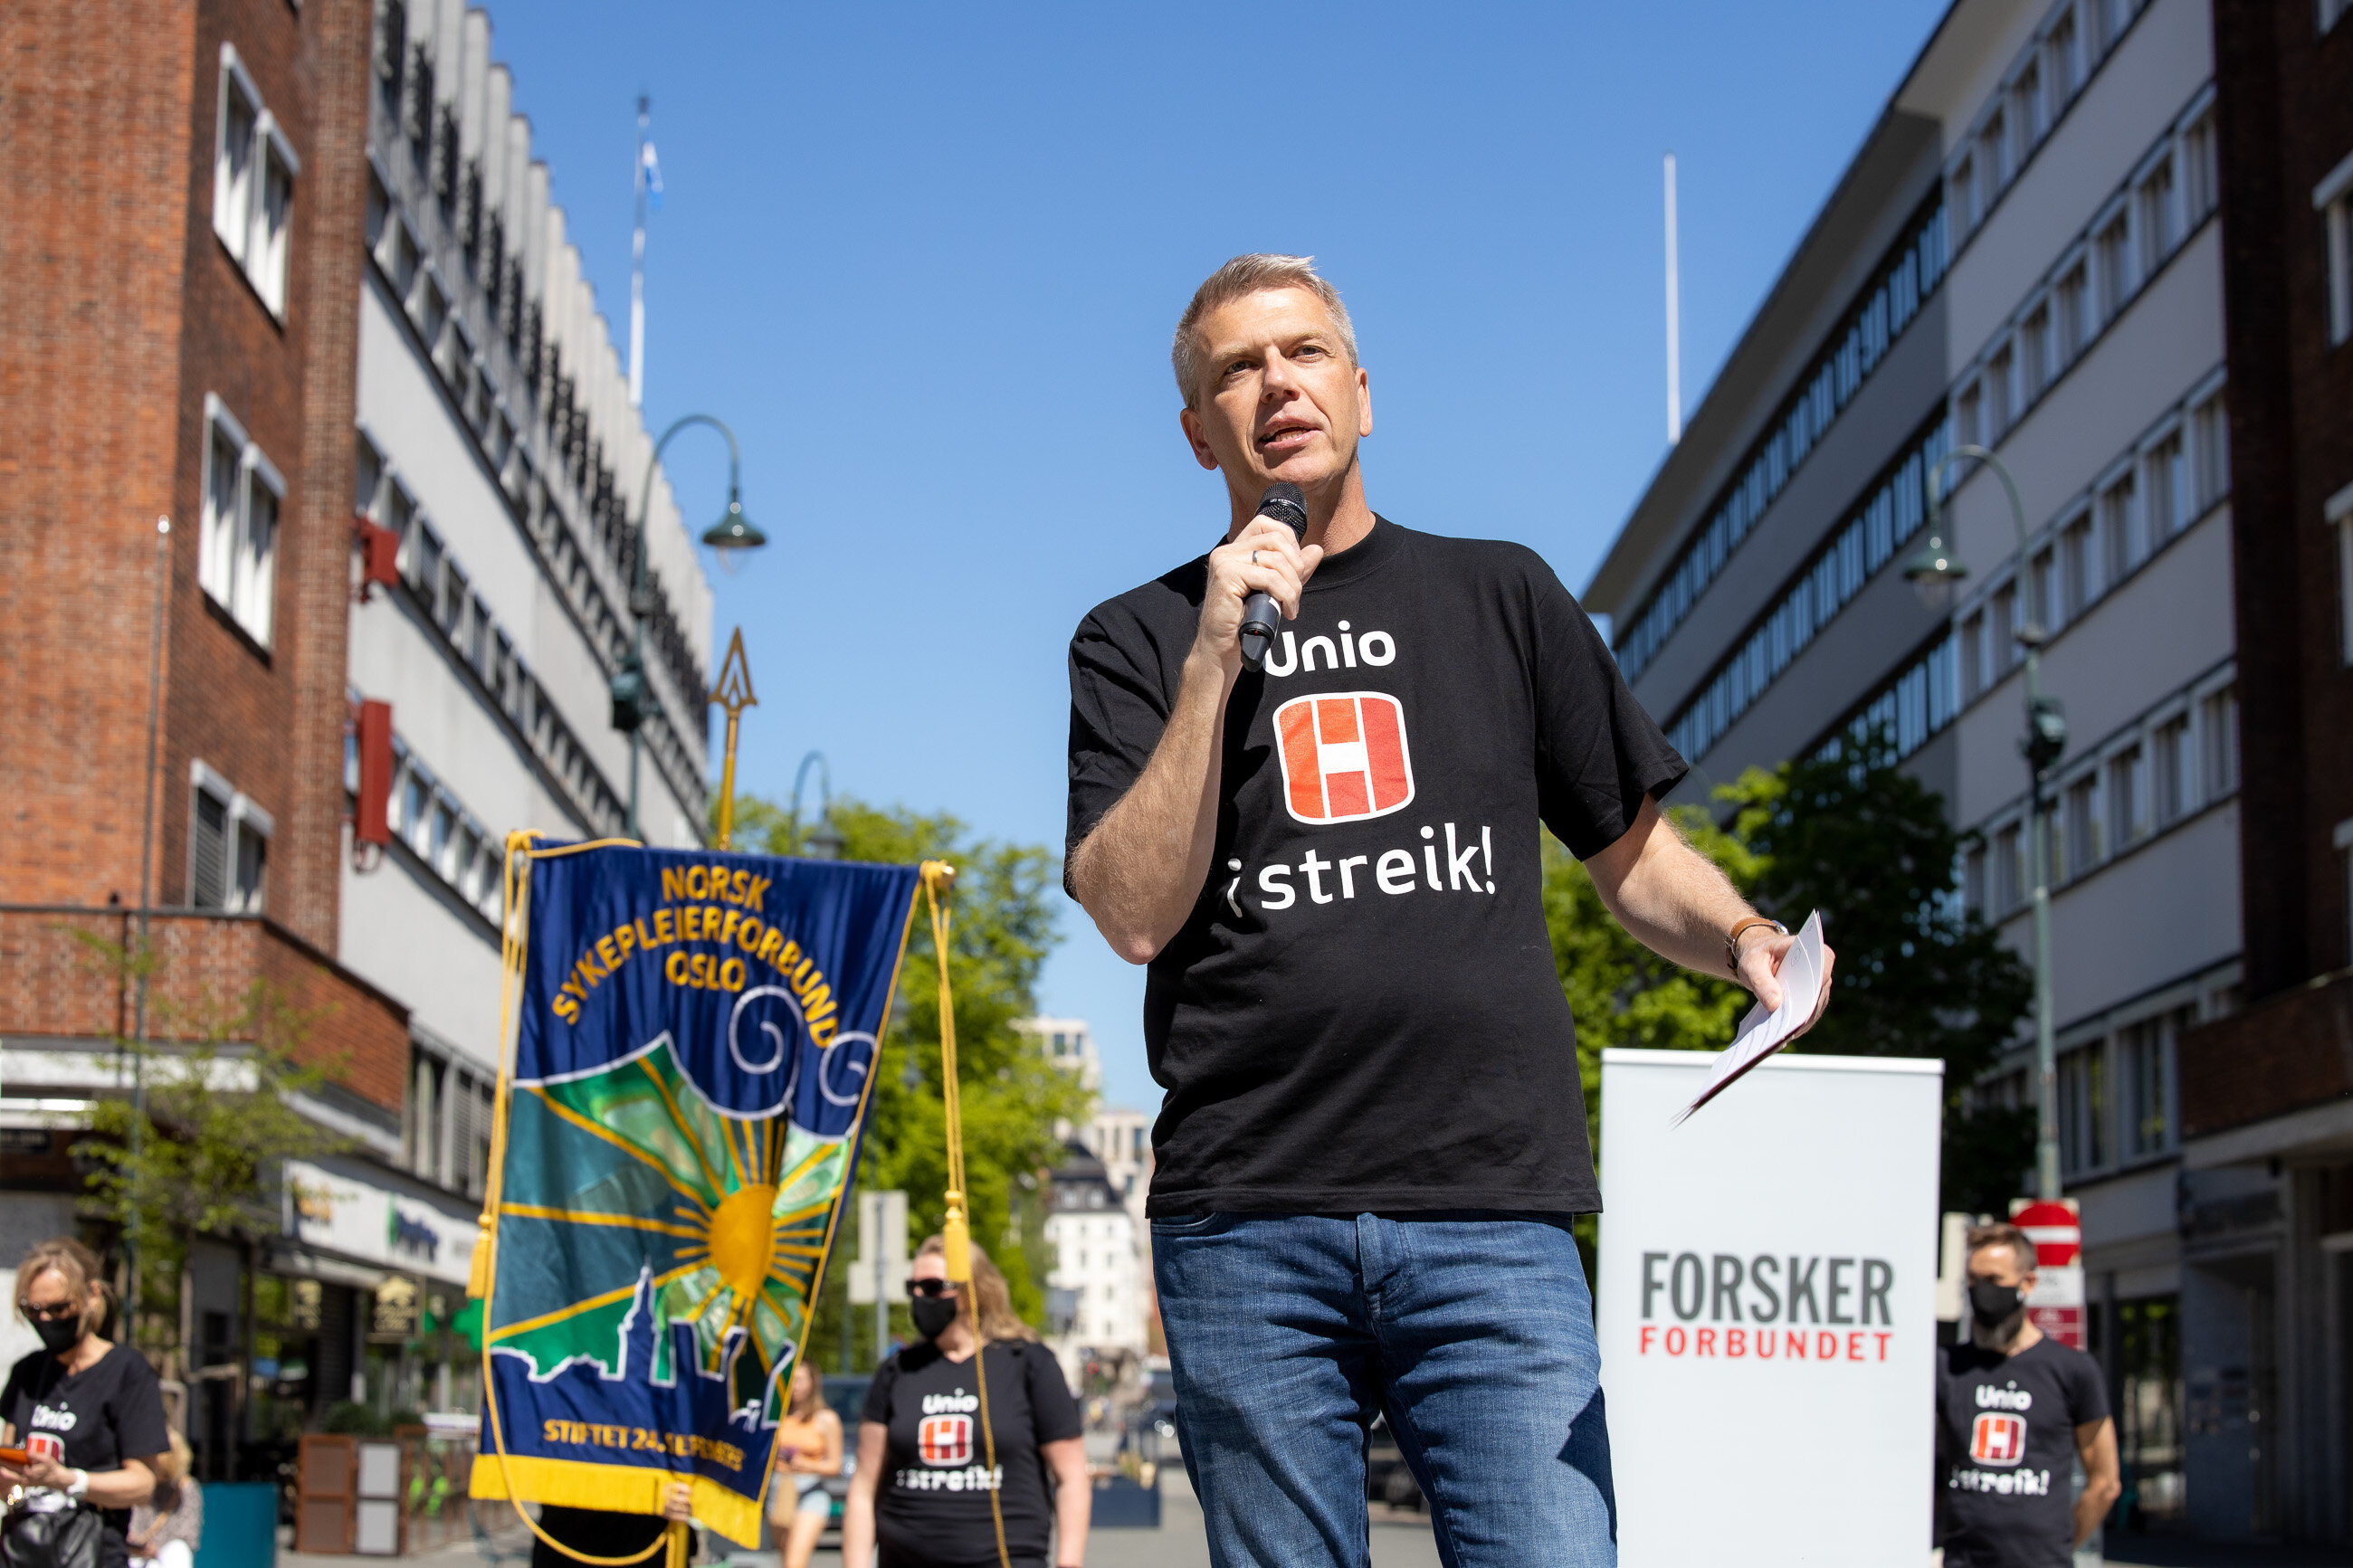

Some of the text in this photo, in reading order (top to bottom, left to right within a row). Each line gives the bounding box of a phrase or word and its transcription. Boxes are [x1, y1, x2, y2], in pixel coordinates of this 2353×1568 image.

[1263, 620, 1396, 677] Unio
[661, 864, 771, 912] NORSK
[1258, 822, 1496, 910] streik!
[552, 906, 838, 1048] SYKEPLEIERFORBUND
[665, 950, 747, 993] OSLO
[1642, 1252, 1894, 1326] FORSKER
[1640, 1326, 1893, 1361] FORBUNDET
[922, 1388, 979, 1414] Unio
[1976, 1380, 2033, 1411] Unio
[544, 1419, 631, 1449] STIFTET
